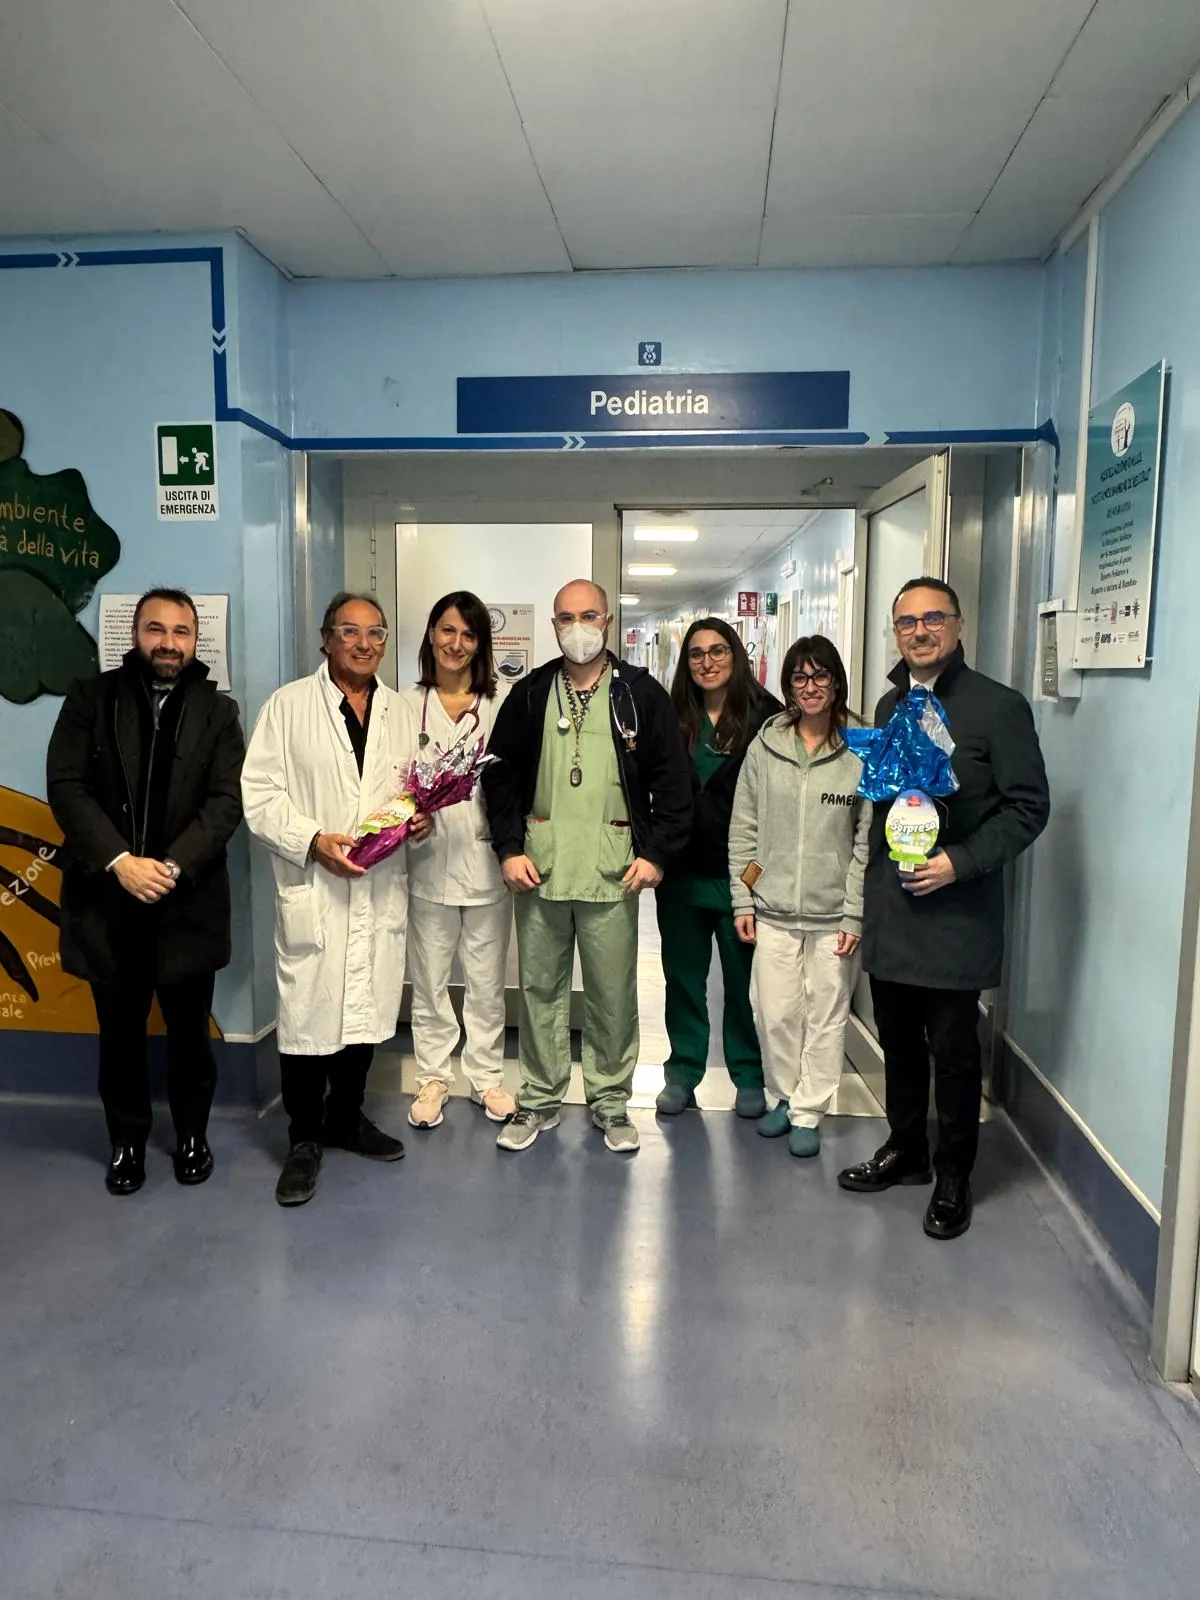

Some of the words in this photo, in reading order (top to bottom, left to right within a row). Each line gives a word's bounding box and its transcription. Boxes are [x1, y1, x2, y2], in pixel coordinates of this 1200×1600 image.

[590, 389, 709, 416] Pediatria
[165, 490, 199, 501] USCITA
[201, 490, 211, 501] DI
[160, 504, 216, 515] EMERGENZA
[17, 529, 54, 557] della
[60, 540, 100, 569] vita
[890, 818, 937, 836] Sorpresa
[0, 846, 56, 906] ezione
